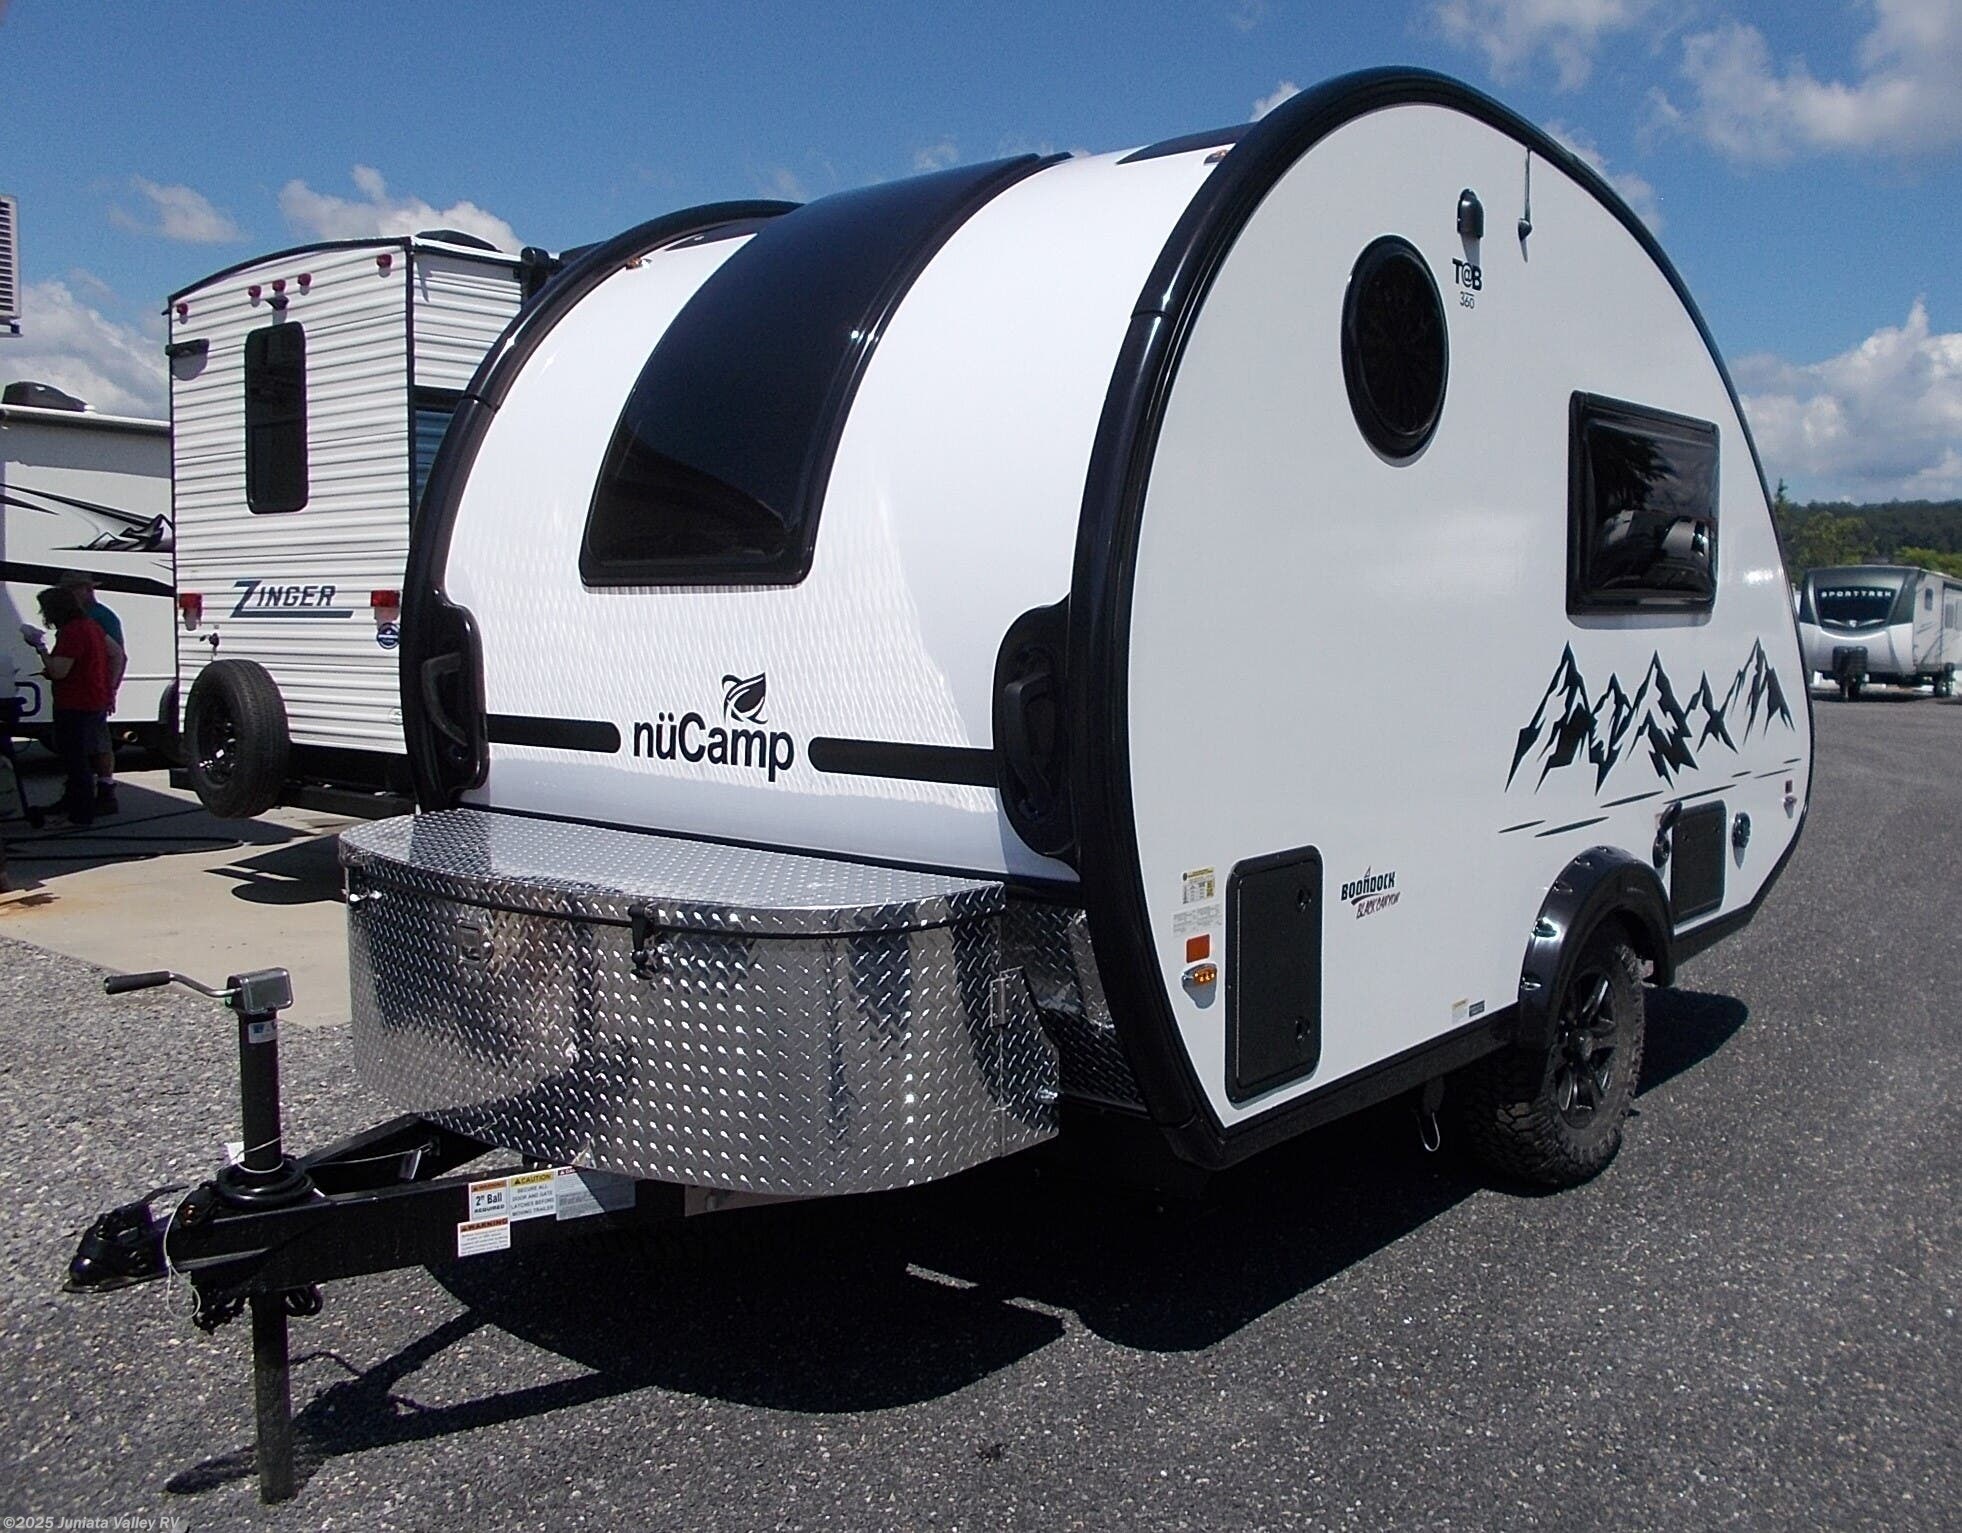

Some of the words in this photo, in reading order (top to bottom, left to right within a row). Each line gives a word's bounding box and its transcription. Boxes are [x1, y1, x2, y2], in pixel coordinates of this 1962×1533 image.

[1452, 257, 1483, 291] T@B
[1460, 291, 1475, 309] 360
[230, 580, 340, 618] ZINGER
[634, 711, 795, 783] nüCamp
[1341, 871, 1396, 902] BOONDOCK
[521, 1174, 551, 1184] CAUTION
[475, 1195, 485, 1206] 2"
[487, 1192, 503, 1205] Ball
[474, 1204, 505, 1213] REQUIRED
[468, 1218, 508, 1230] WARNING
